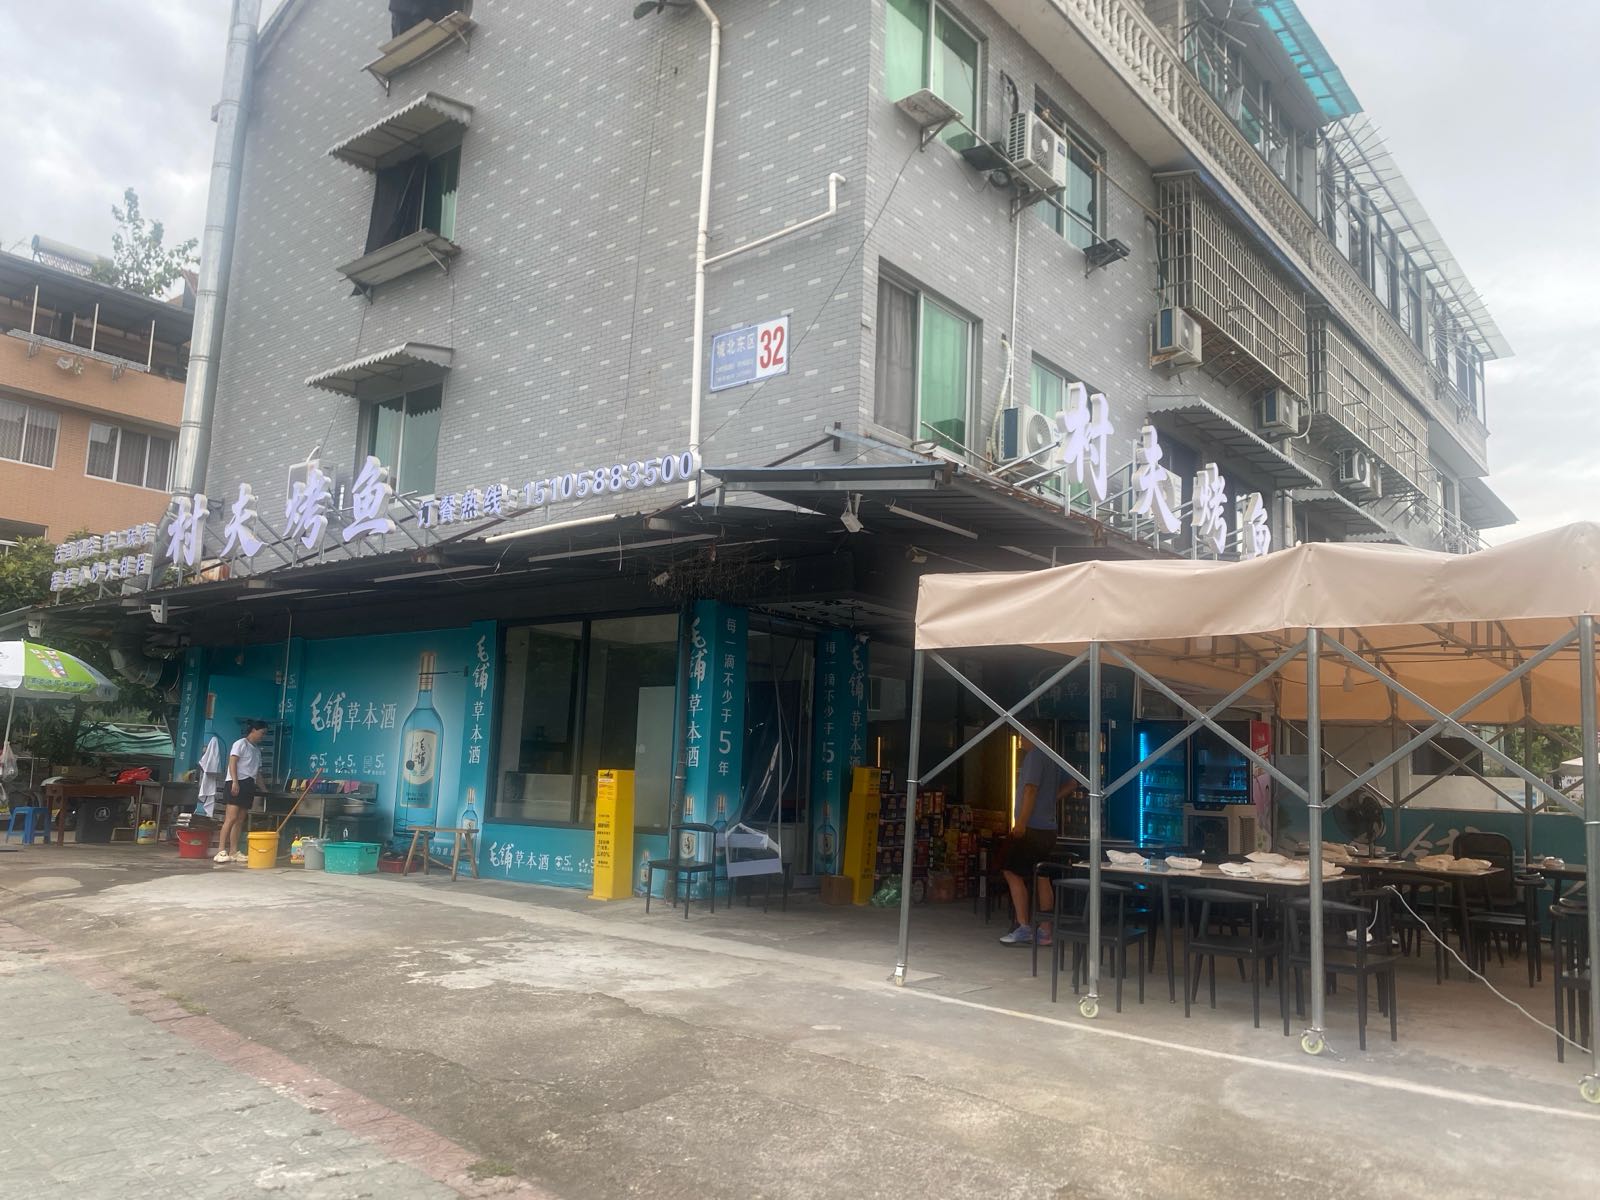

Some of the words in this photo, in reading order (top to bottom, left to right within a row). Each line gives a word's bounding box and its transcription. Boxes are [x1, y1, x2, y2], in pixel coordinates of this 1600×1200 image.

[759, 325, 785, 369] 32
[166, 455, 397, 567] 村夫烤鱼
[523, 451, 695, 506] 15105883500
[1056, 382, 1272, 558] 村夫烤鱼
[310, 691, 398, 743] 毛铺草本酒
[468, 635, 490, 765] 毛铺草本酒
[717, 617, 738, 777] 每一滴不少于5年
[489, 841, 550, 877] 毛铺草本酒
